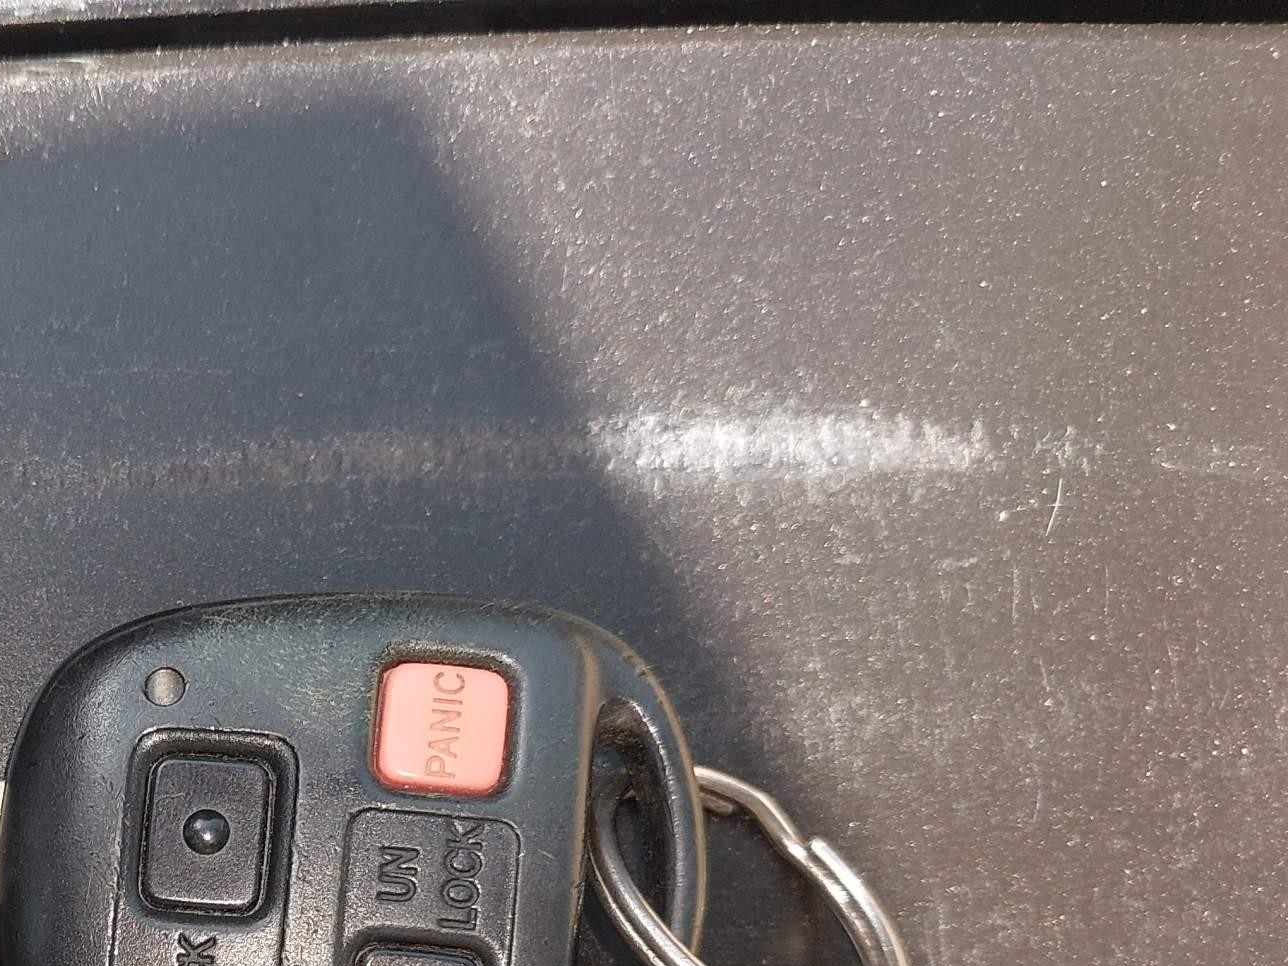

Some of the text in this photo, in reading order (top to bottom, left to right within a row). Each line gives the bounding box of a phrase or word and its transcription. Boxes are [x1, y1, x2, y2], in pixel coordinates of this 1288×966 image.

[424, 670, 466, 779] PANIC
[375, 845, 421, 903] UN
[436, 818, 486, 931] LOCK
